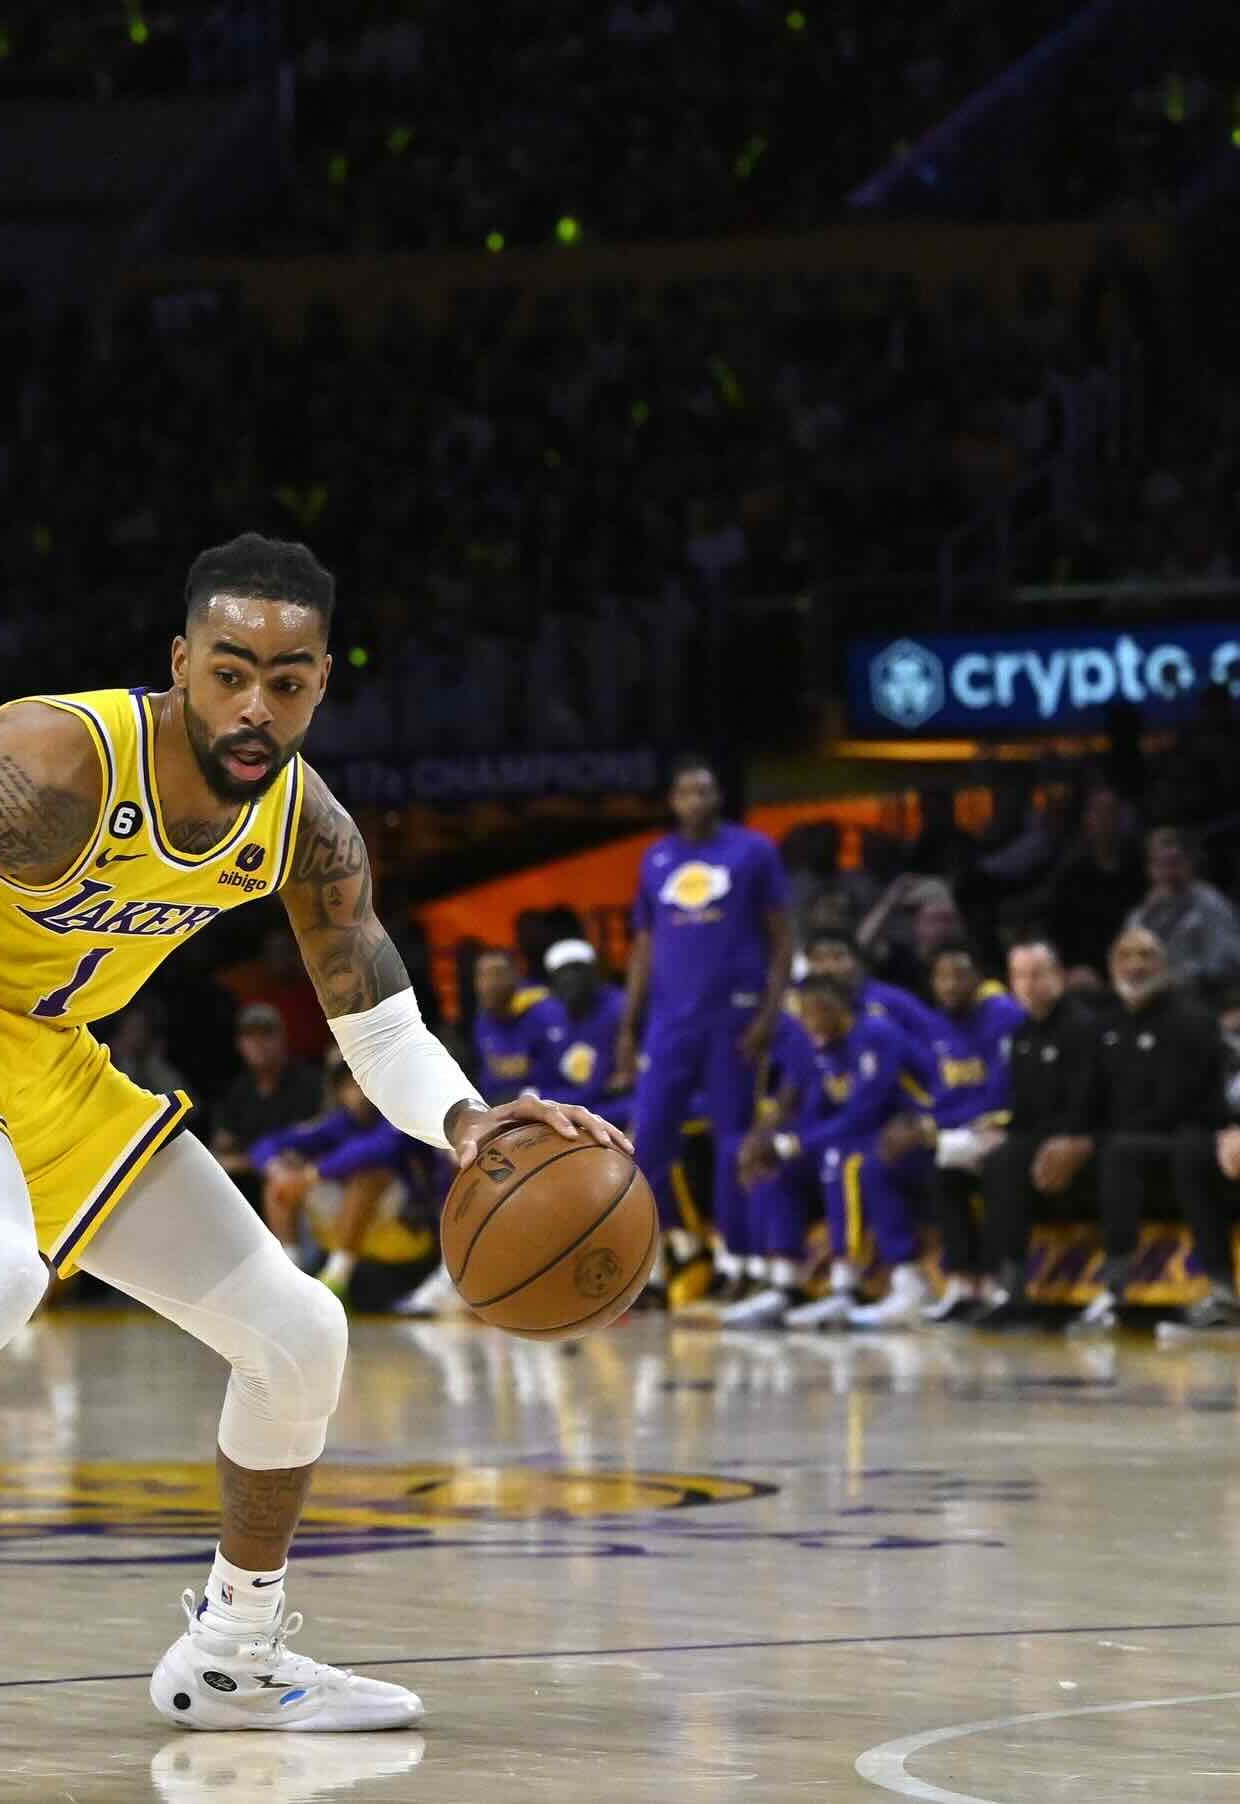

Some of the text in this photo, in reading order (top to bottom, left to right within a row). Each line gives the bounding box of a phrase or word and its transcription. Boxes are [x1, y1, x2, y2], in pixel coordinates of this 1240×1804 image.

[113, 807, 136, 835] 6
[217, 870, 267, 892] bibigo
[16, 878, 221, 934] LAKER
[31, 947, 115, 1017] 1
